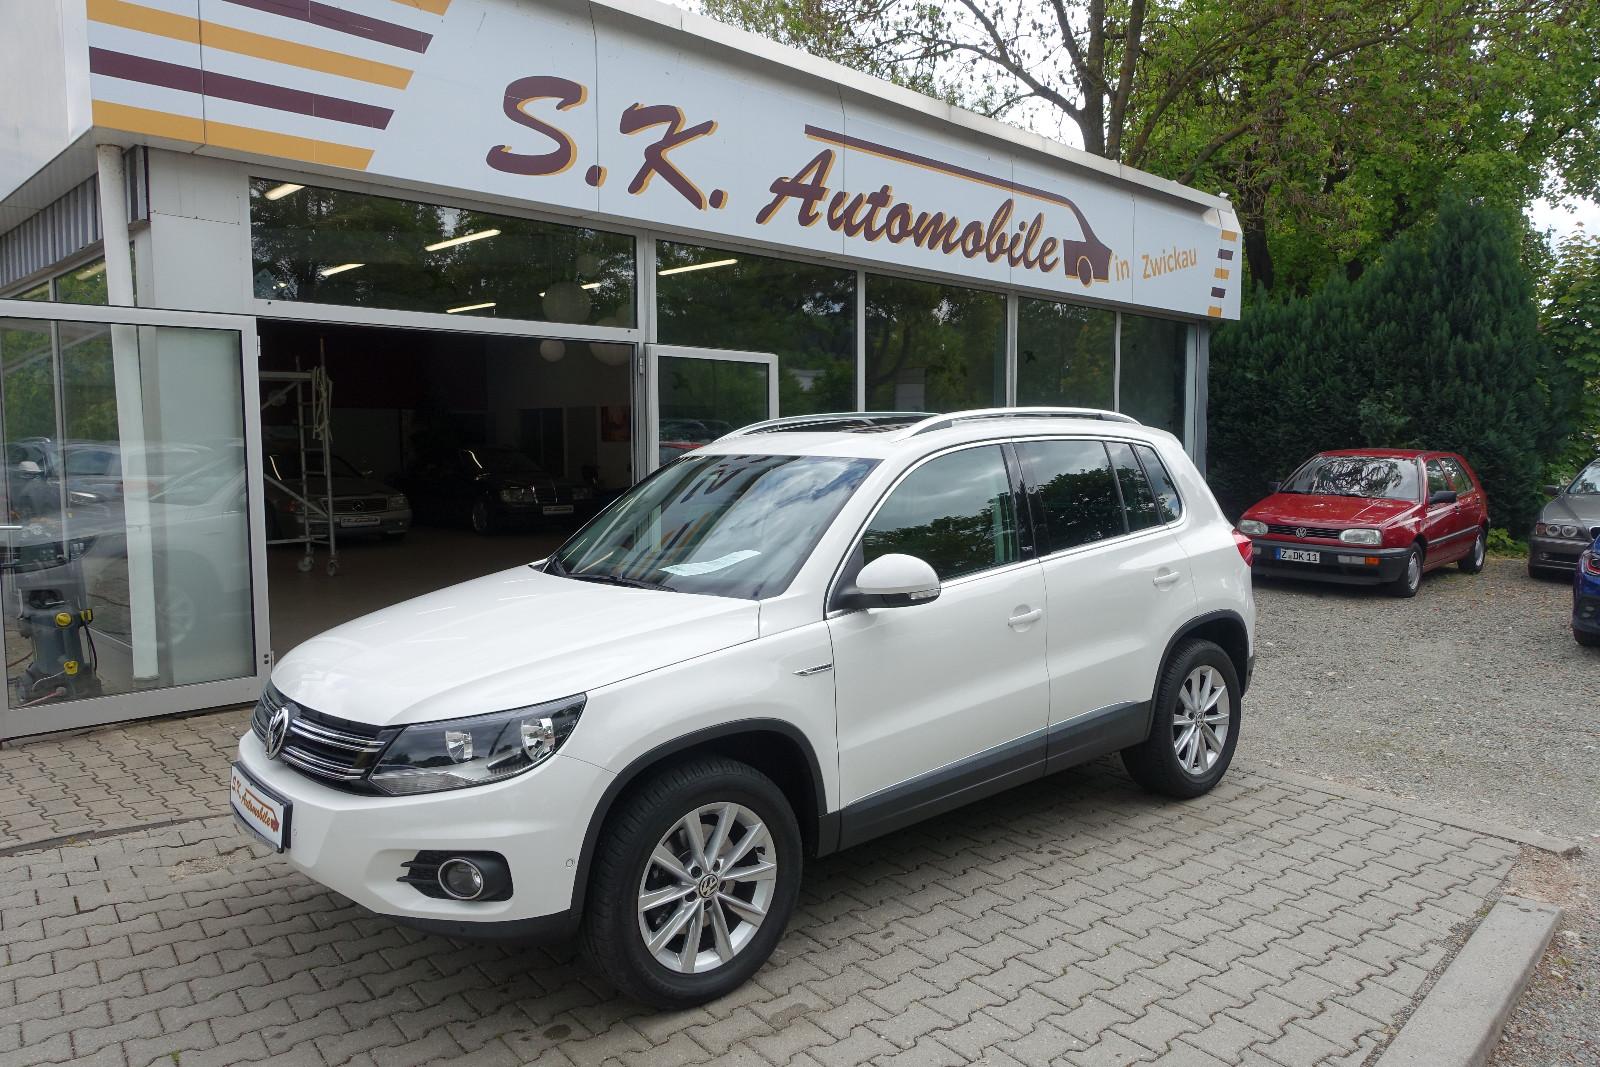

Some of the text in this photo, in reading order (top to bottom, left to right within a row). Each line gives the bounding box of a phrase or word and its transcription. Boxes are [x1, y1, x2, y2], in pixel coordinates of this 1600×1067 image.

[755, 148, 1060, 273] Automobile
[1115, 254, 1130, 281] in
[1142, 246, 1197, 280] Zwickau
